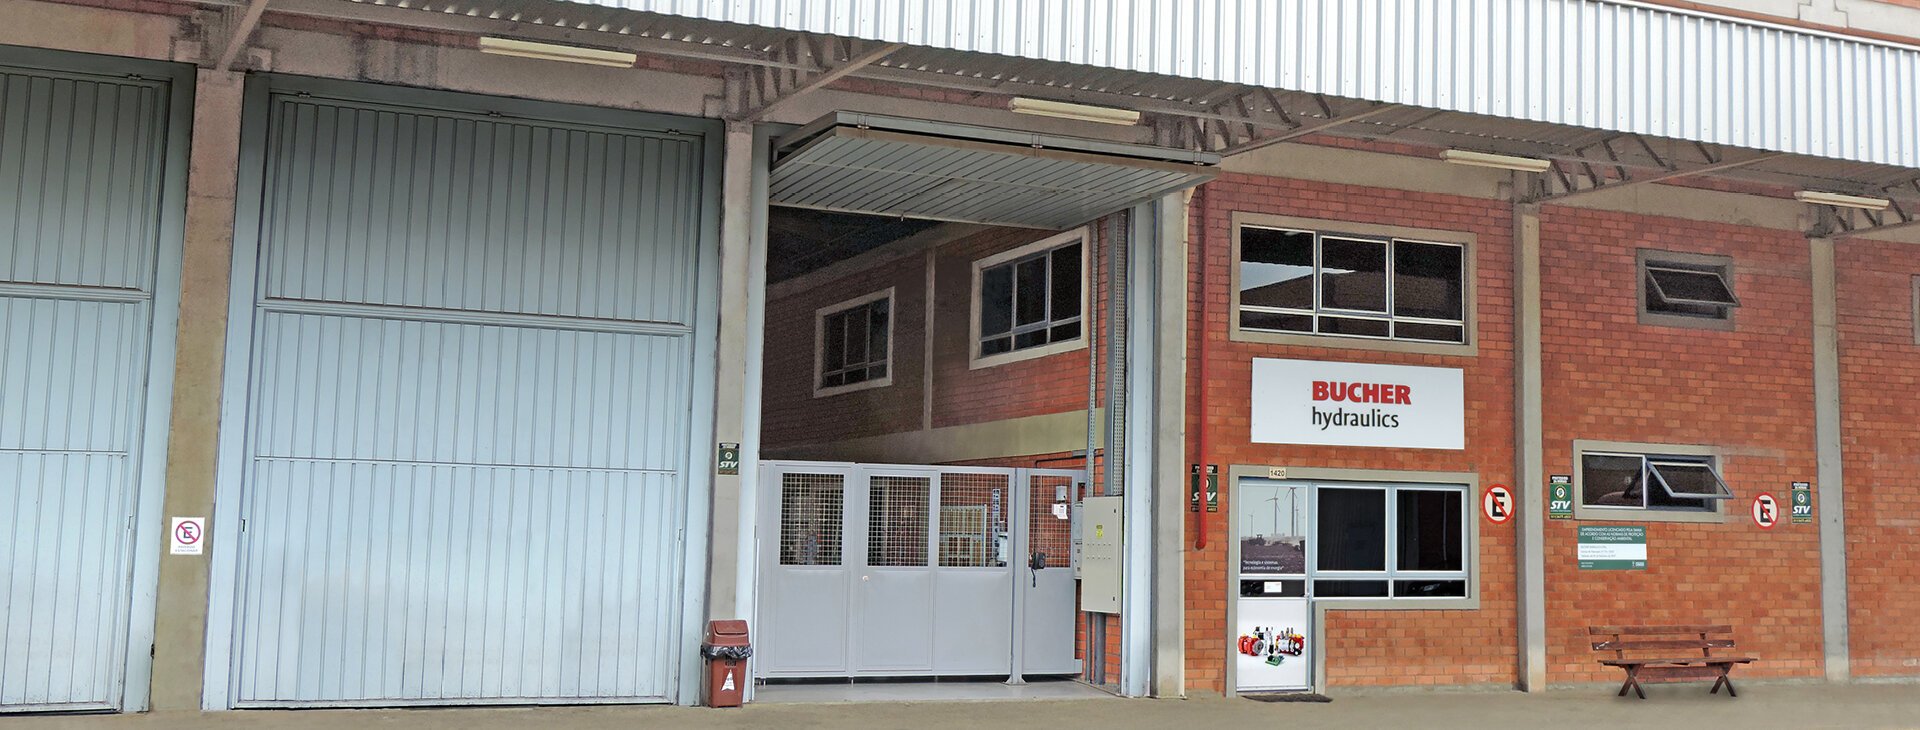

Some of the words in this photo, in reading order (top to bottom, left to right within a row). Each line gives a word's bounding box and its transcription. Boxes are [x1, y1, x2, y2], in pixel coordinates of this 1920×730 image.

[1312, 381, 1411, 405] BUCHER
[1312, 406, 1399, 431] hydraulics
[1191, 491, 1217, 502] SV
[1550, 500, 1571, 510] STV
[1792, 505, 1811, 514] STV
